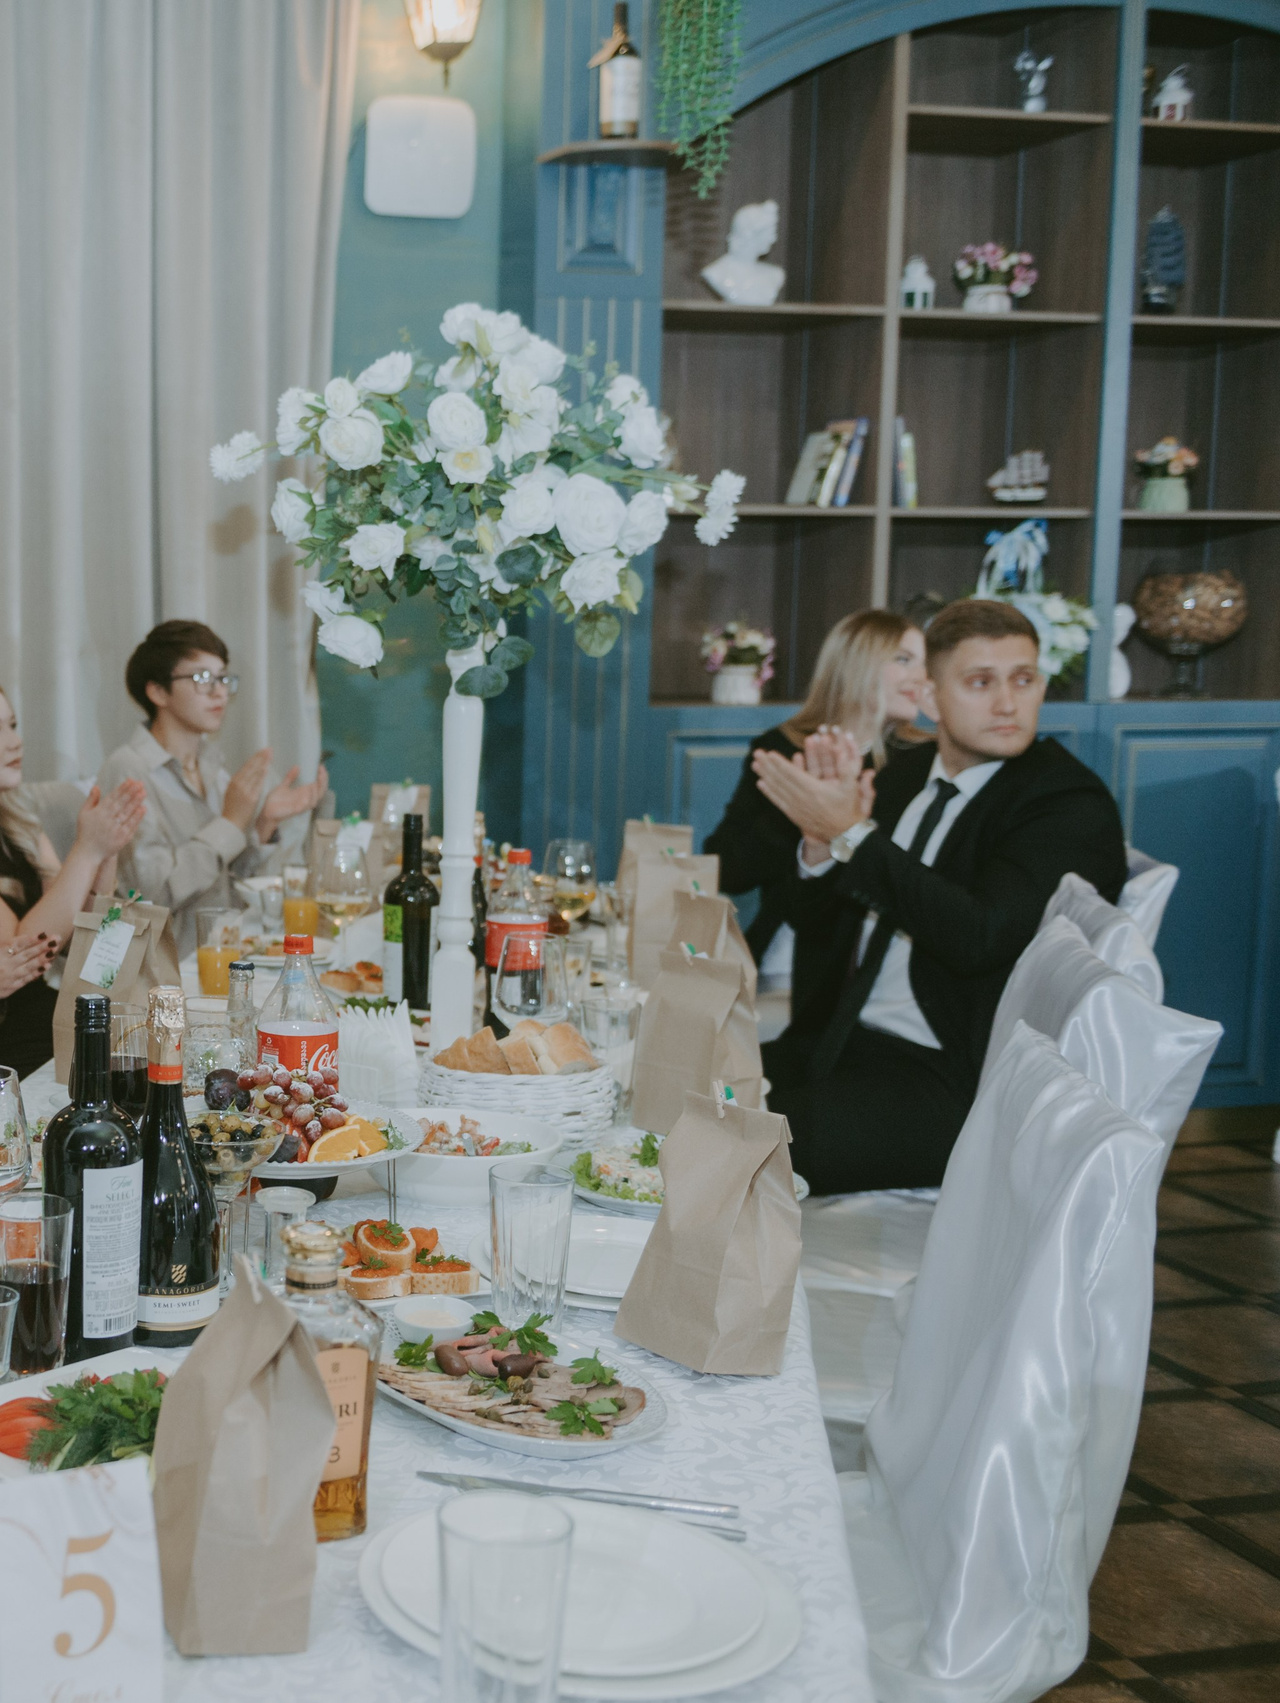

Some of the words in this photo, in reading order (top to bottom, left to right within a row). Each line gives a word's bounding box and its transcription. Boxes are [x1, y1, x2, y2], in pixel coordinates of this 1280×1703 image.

[105, 1189, 135, 1202] SELECT
[147, 1284, 206, 1295] FANAGORIA
[153, 1299, 201, 1309] SEMI-SWEET
[53, 1528, 116, 1658] 5
